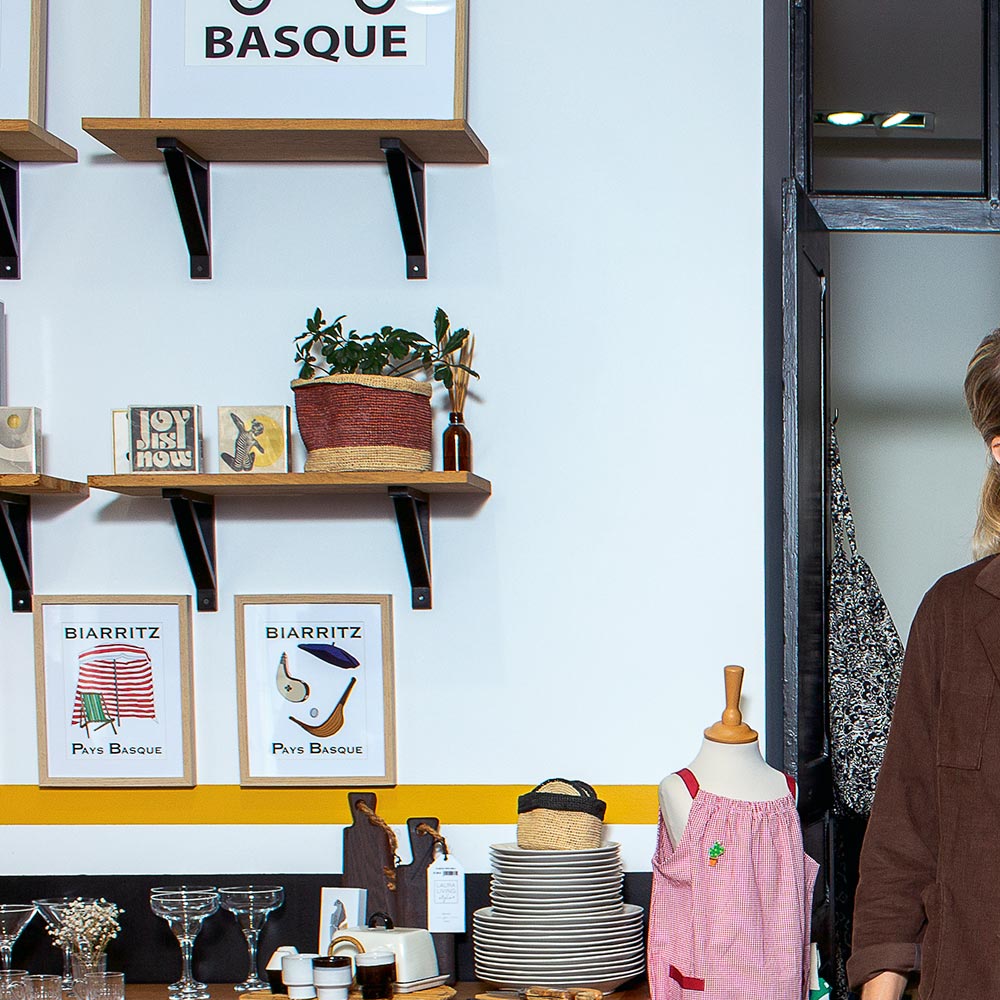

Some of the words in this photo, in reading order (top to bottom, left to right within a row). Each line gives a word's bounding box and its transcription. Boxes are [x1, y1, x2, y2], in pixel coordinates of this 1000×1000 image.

[205, 25, 407, 62] BASQUE
[136, 410, 191, 450] JOY
[65, 627, 160, 639] BIARRITZ
[265, 627, 362, 639] BIARRITZ
[72, 742, 104, 755] PAYS
[109, 742, 162, 755] BASQUE
[272, 742, 305, 755] PAYS
[309, 742, 363, 755] BASQUE
